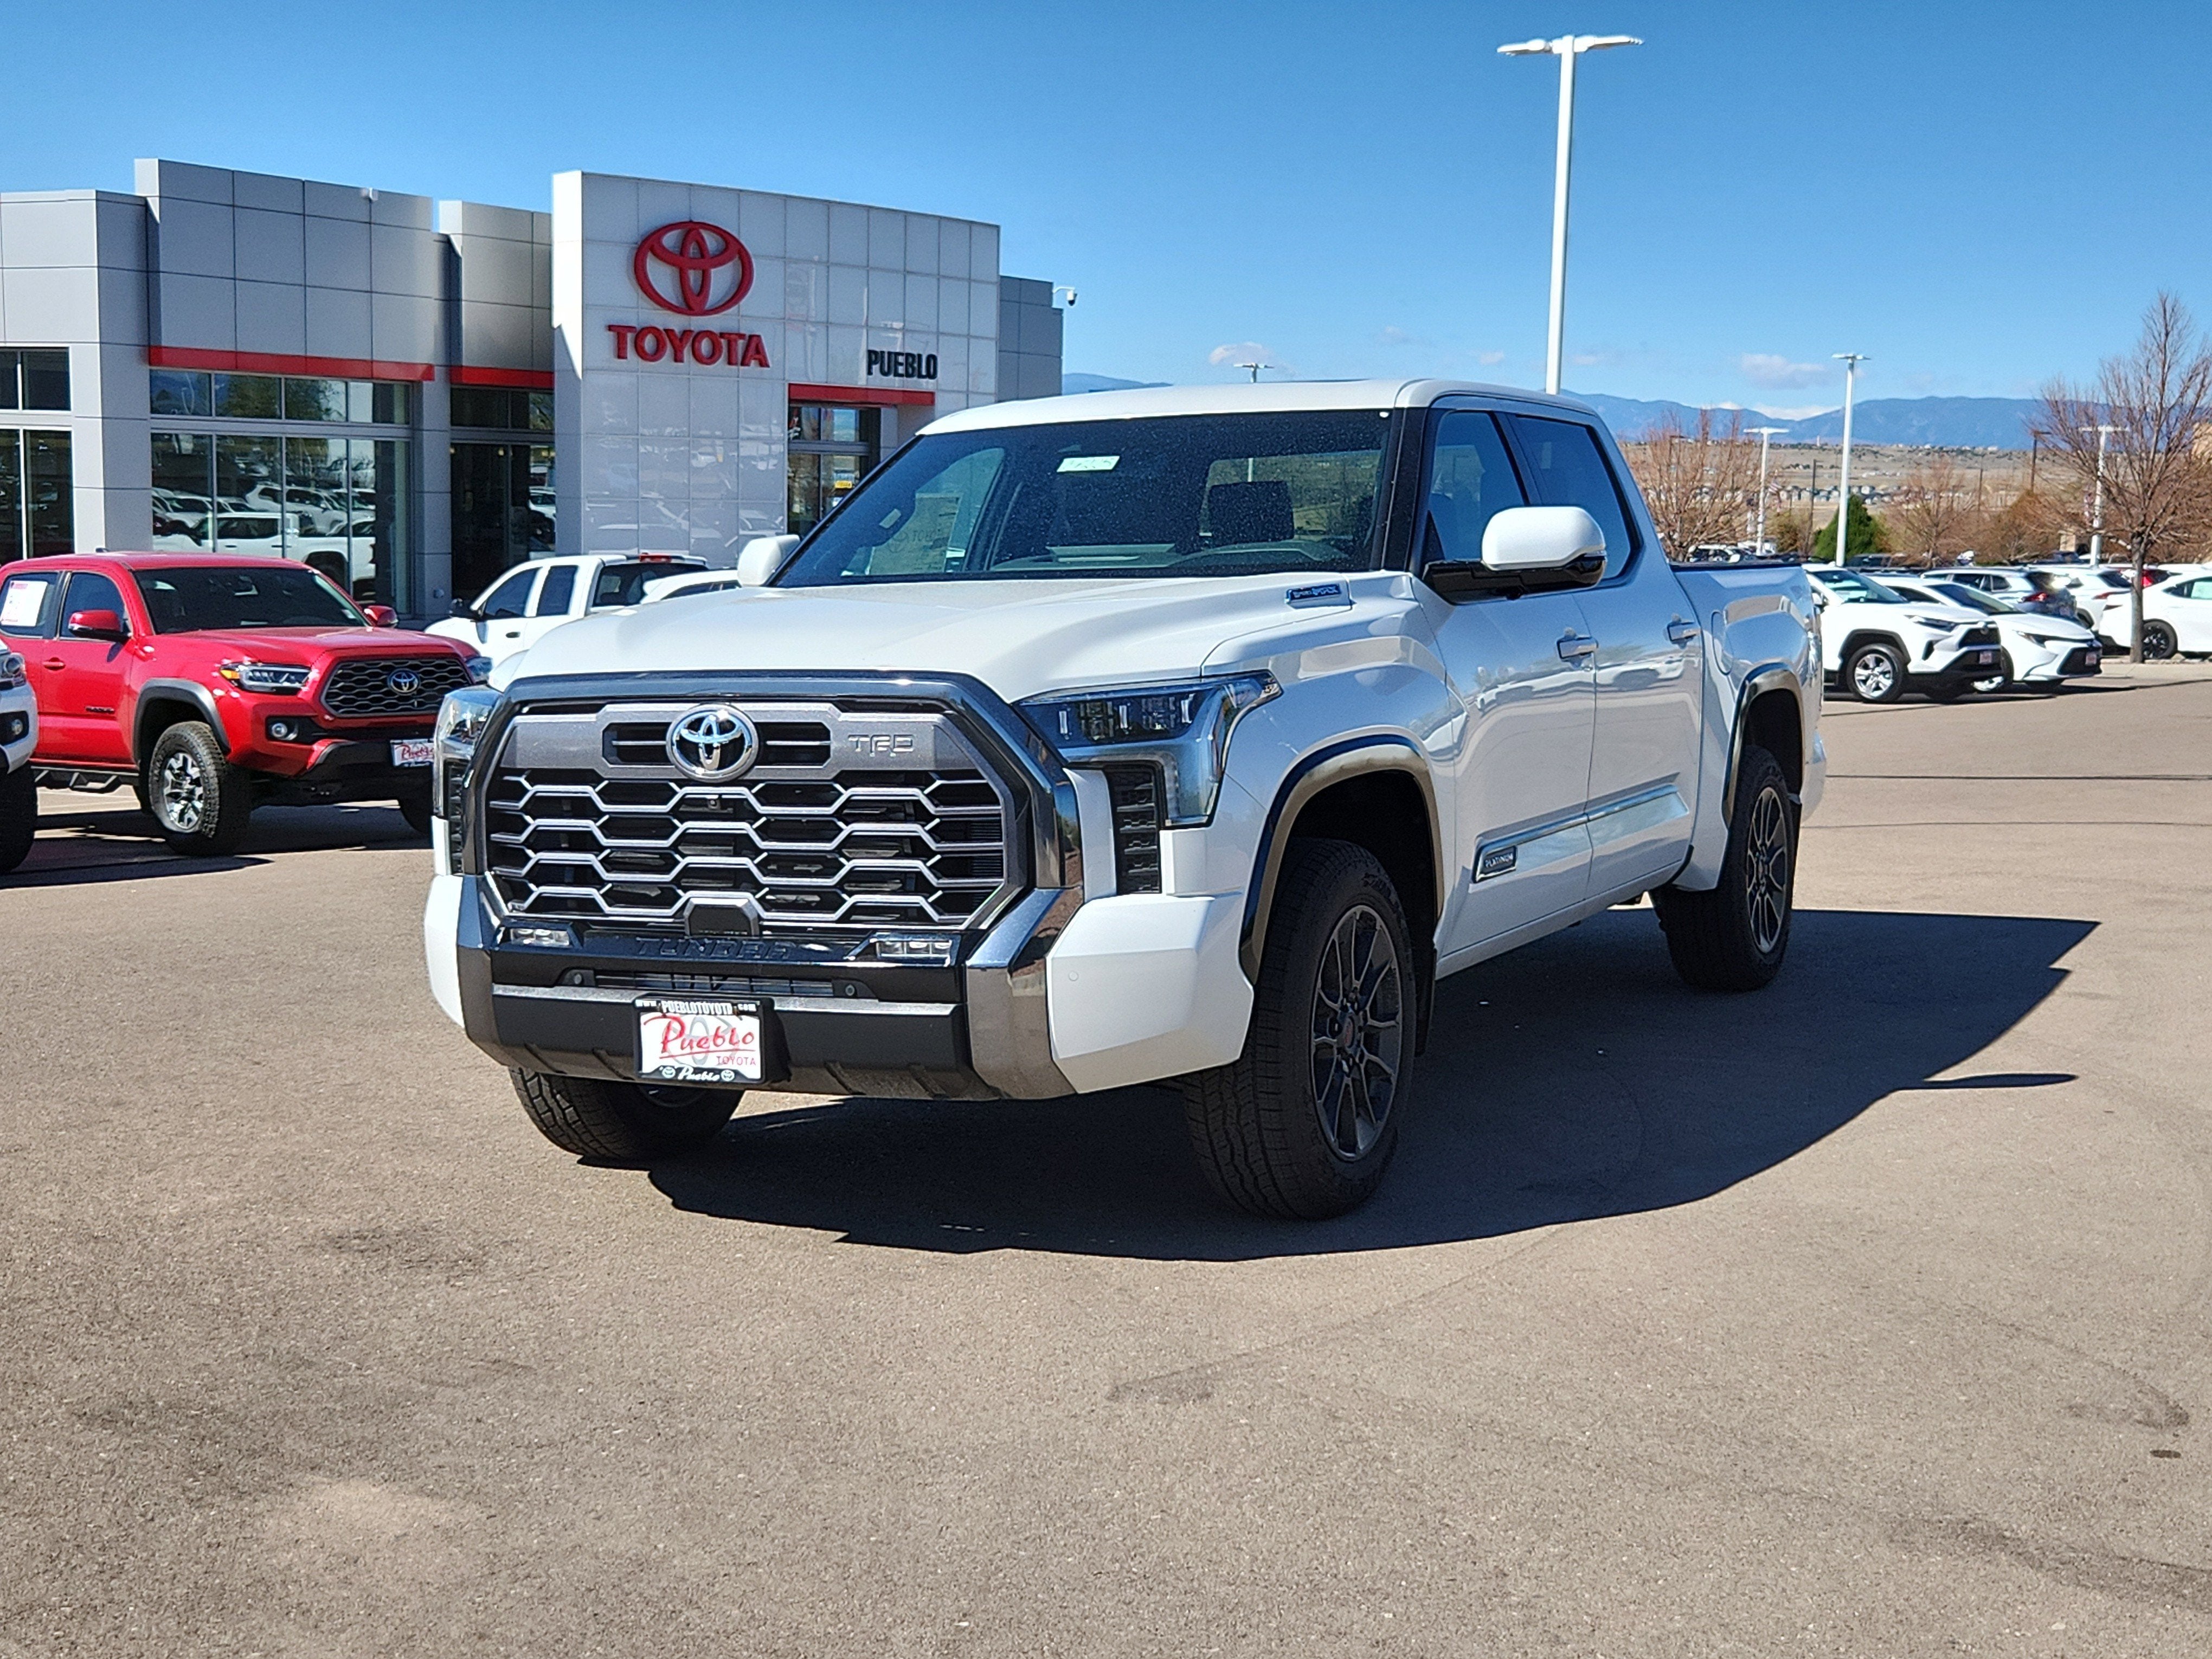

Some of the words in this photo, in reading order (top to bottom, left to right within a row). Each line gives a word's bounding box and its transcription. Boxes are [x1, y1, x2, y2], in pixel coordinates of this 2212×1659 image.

[608, 324, 770, 368] TOYOTA
[867, 350, 938, 380] PUEBLO
[847, 734, 915, 757] TRD
[635, 936, 796, 959] TUNDRA
[644, 1015, 755, 1053] Pueblo
[716, 1056, 756, 1066] TOYOTA
[676, 1066, 720, 1081] Pueblo
